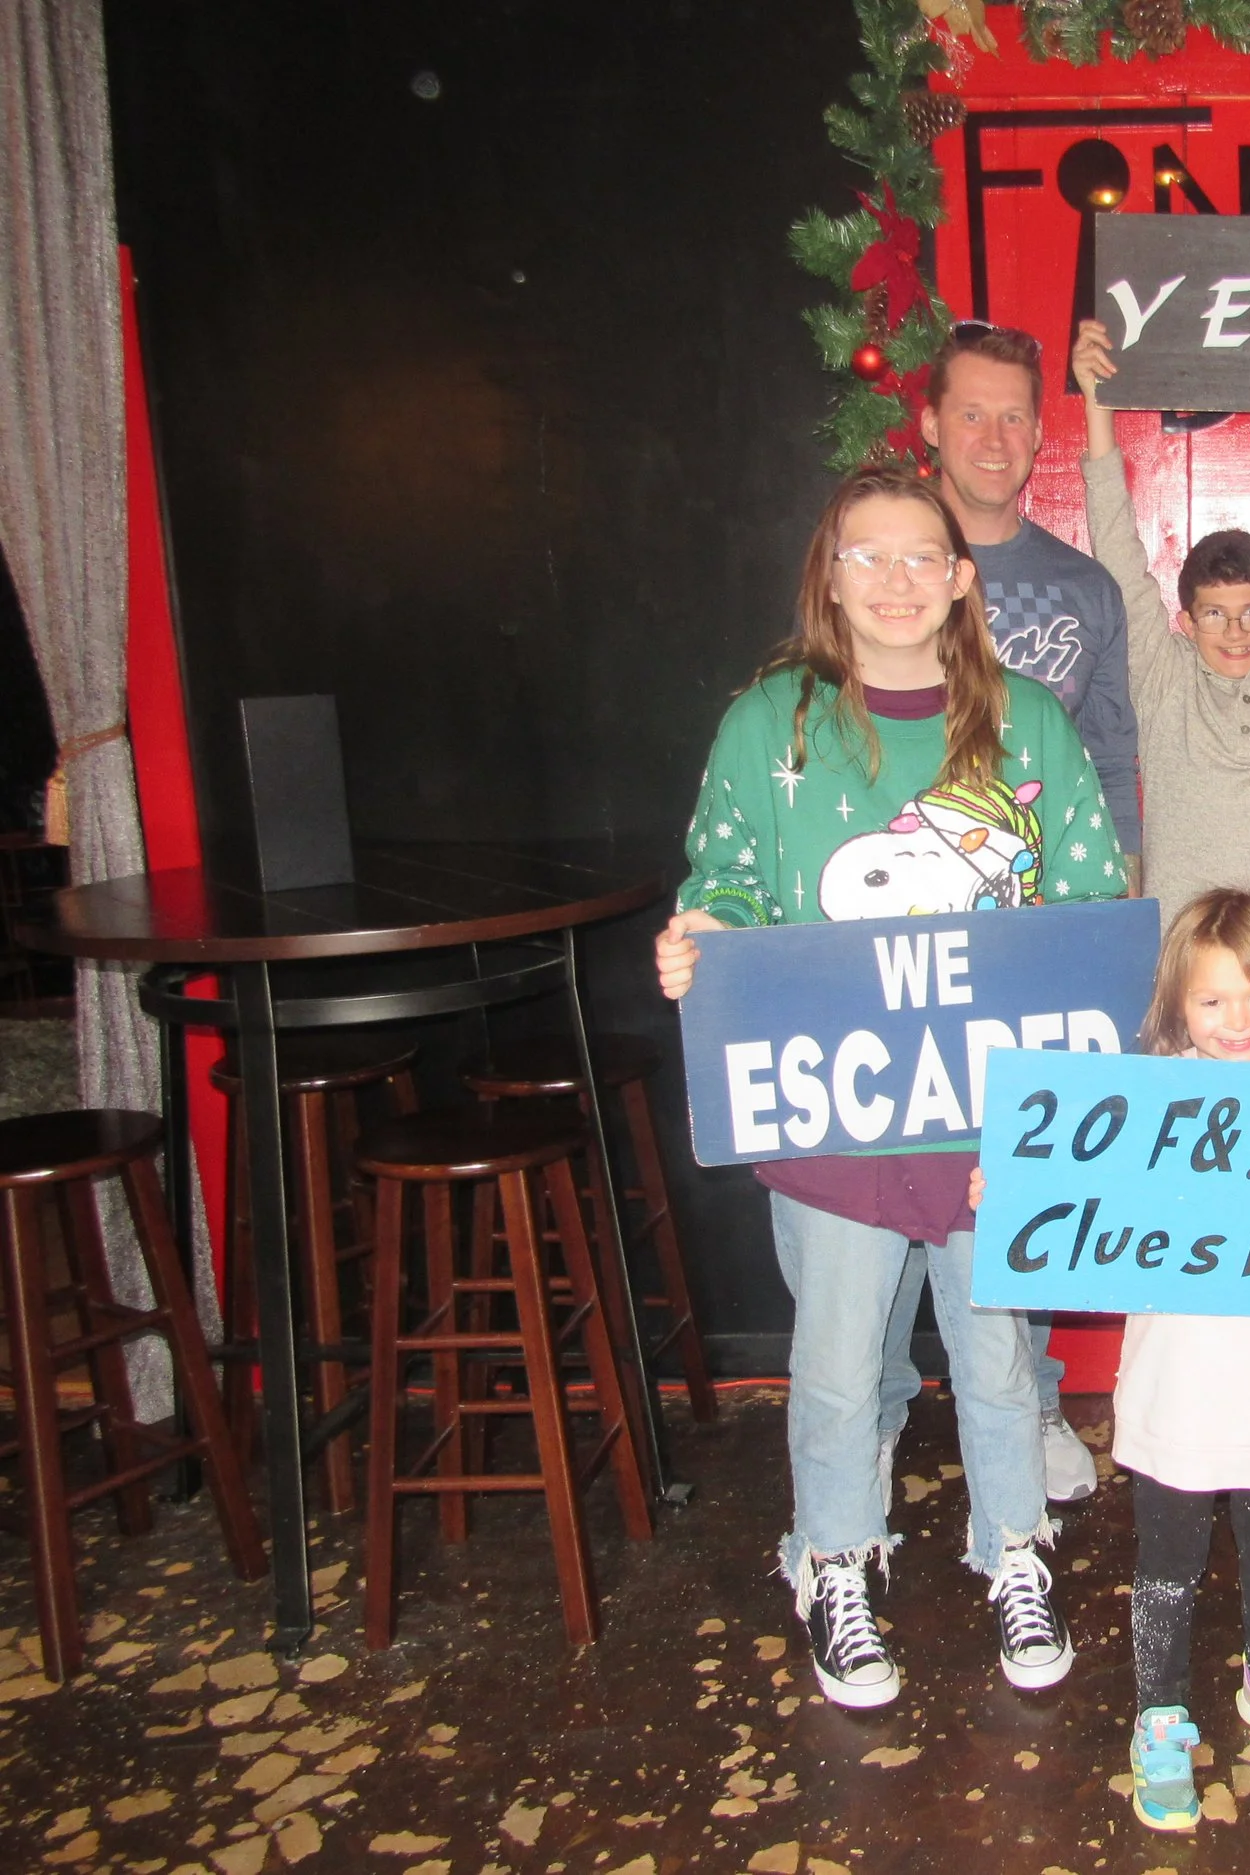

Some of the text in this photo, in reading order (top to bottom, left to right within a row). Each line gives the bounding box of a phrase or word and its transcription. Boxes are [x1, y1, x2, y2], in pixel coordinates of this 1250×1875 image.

[873, 930, 973, 1011] WE
[1012, 1088, 1129, 1162] 20
[1006, 1198, 1228, 1275] Clues
